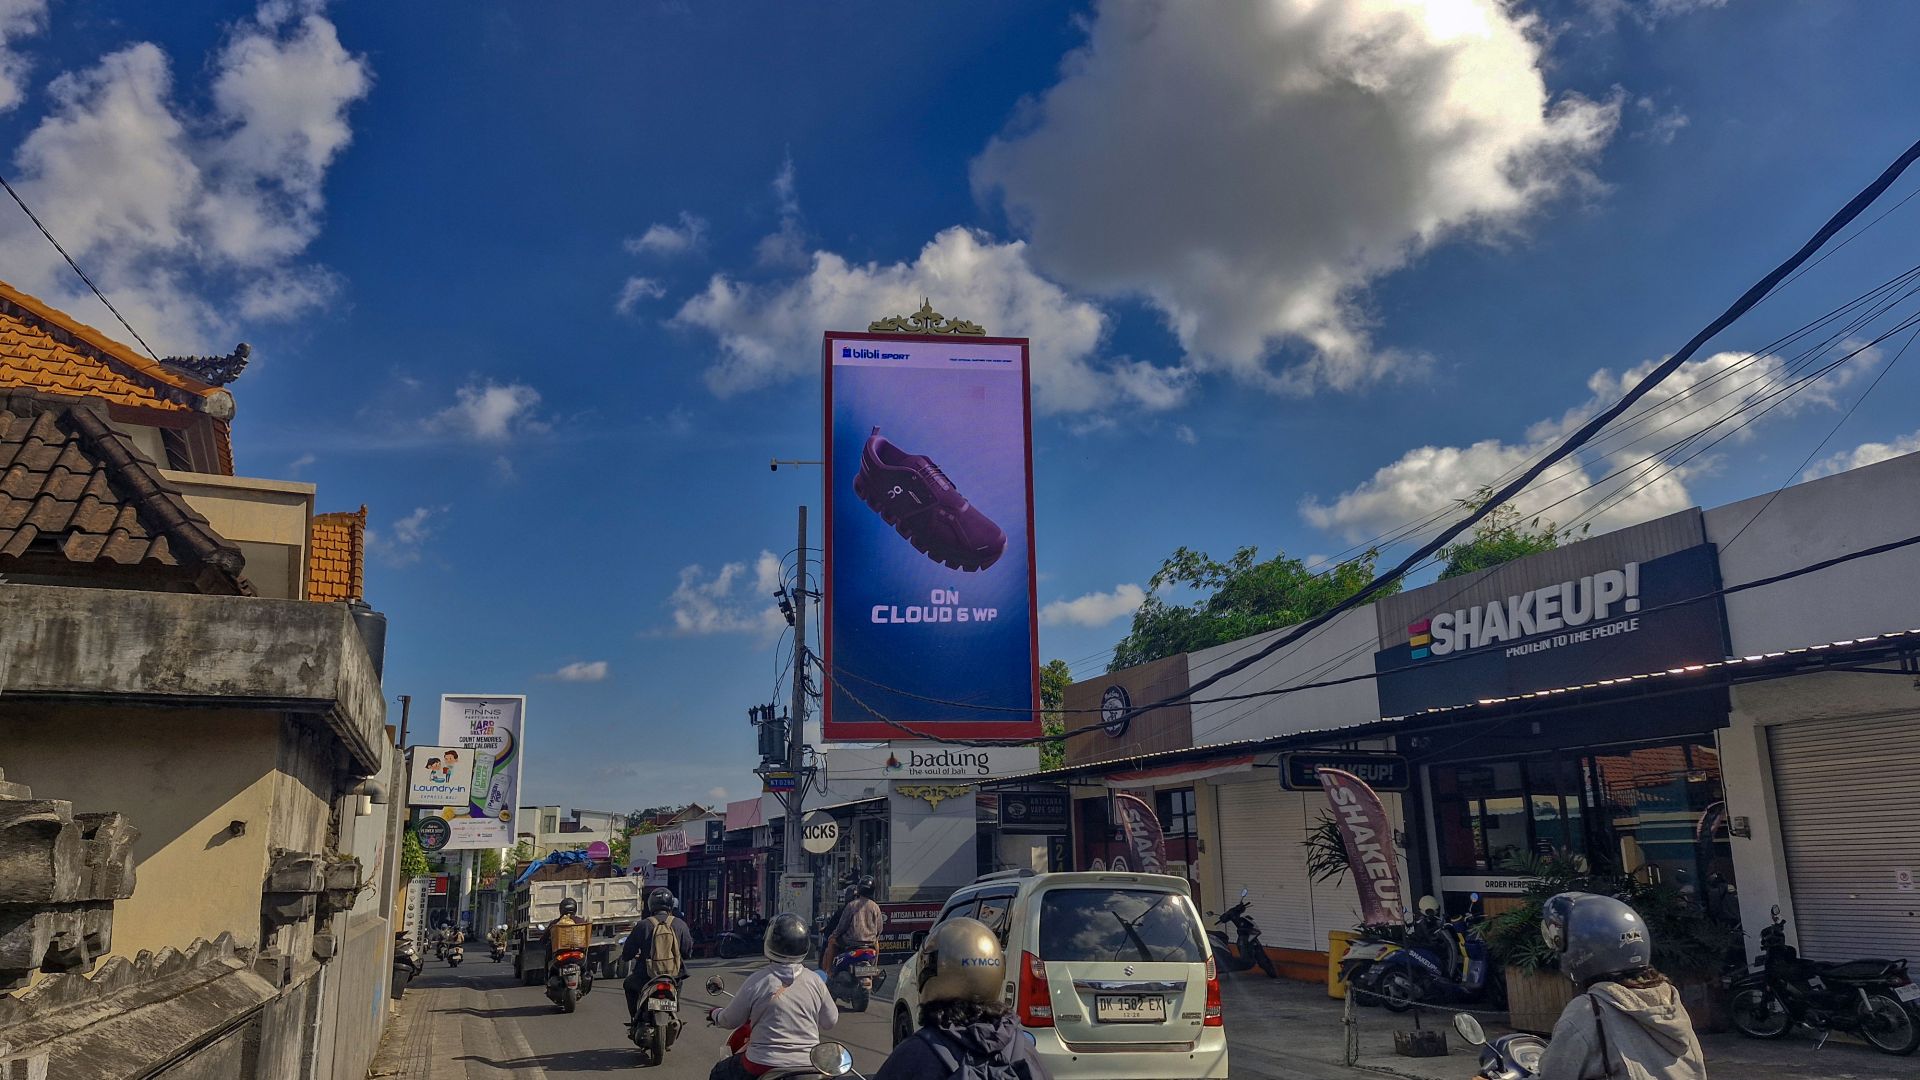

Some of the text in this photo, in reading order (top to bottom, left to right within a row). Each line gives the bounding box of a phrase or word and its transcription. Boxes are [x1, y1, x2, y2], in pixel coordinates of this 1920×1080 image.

[853, 348, 879, 359] blibli
[931, 589, 959, 605] ON
[871, 605, 998, 623] CLOUD 6 WP
[1430, 561, 1640, 656] SHAKEUP!
[1506, 618, 1639, 657] PROTEIN TO THE PEOPLE
[470, 720, 495, 731] HARD
[470, 727, 495, 736] SELTZER
[909, 749, 989, 776] badung
[801, 825, 836, 839] KICKS
[1485, 880, 1508, 888] ORDER
[961, 958, 1000, 967] KYMCO
[1100, 998, 1113, 1011] DK
[1148, 998, 1162, 1011] EX
